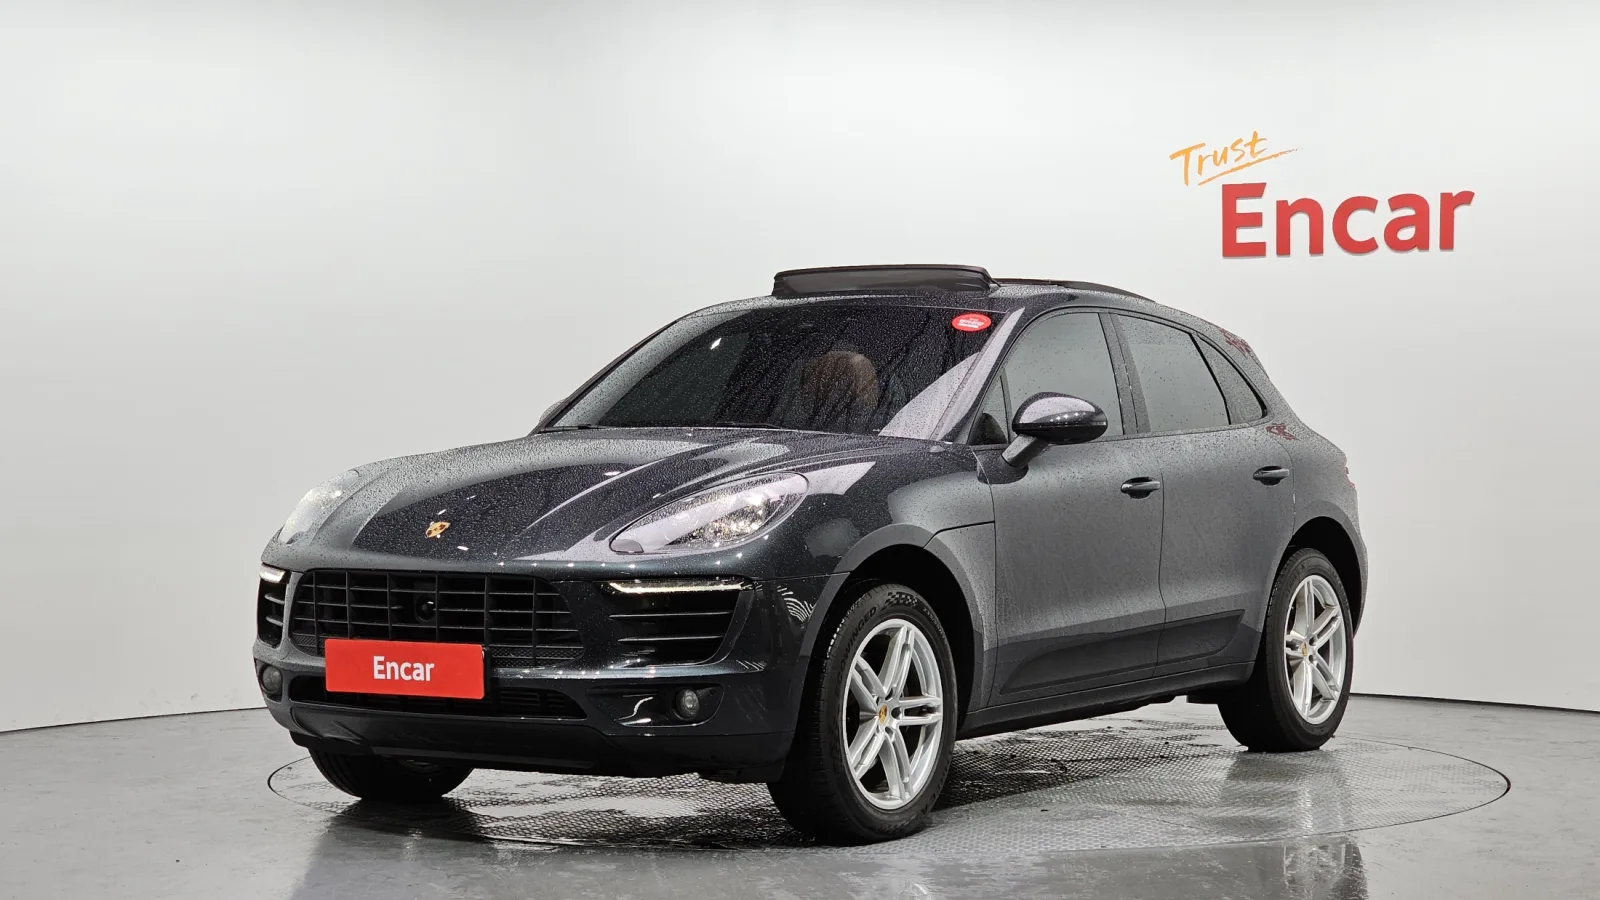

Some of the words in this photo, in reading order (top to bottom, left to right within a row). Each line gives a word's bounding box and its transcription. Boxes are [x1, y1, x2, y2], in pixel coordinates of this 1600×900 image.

[1169, 131, 1268, 187] Trust
[1222, 182, 1475, 258] Encar
[373, 655, 435, 682] Encar
